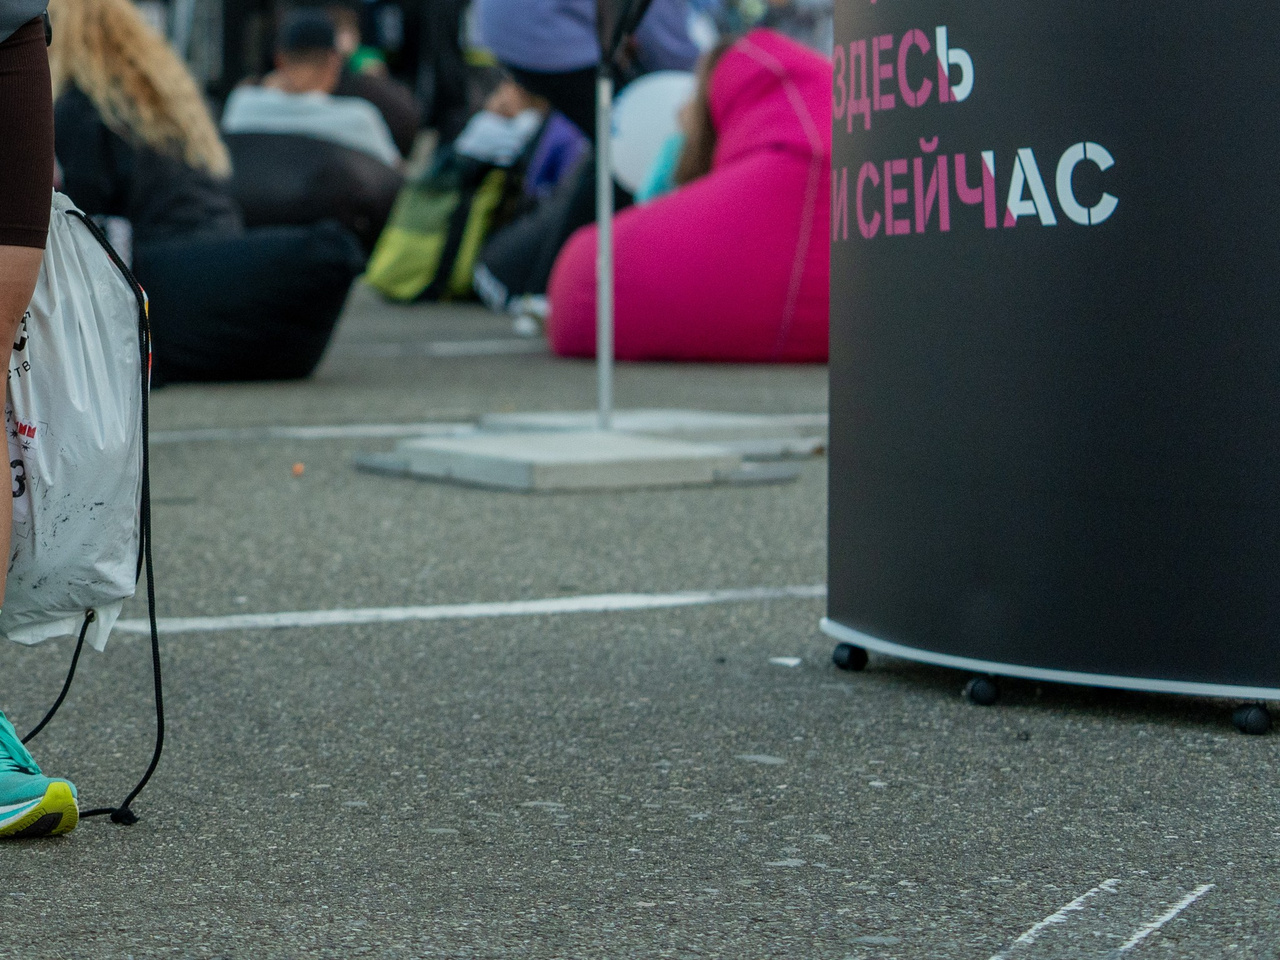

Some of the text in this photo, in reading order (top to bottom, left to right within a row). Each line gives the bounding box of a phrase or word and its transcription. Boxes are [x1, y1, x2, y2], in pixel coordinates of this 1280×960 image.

[833, 25, 975, 134] ЗДЕСЬ
[832, 135, 1118, 242] И СЕЙЧАС
